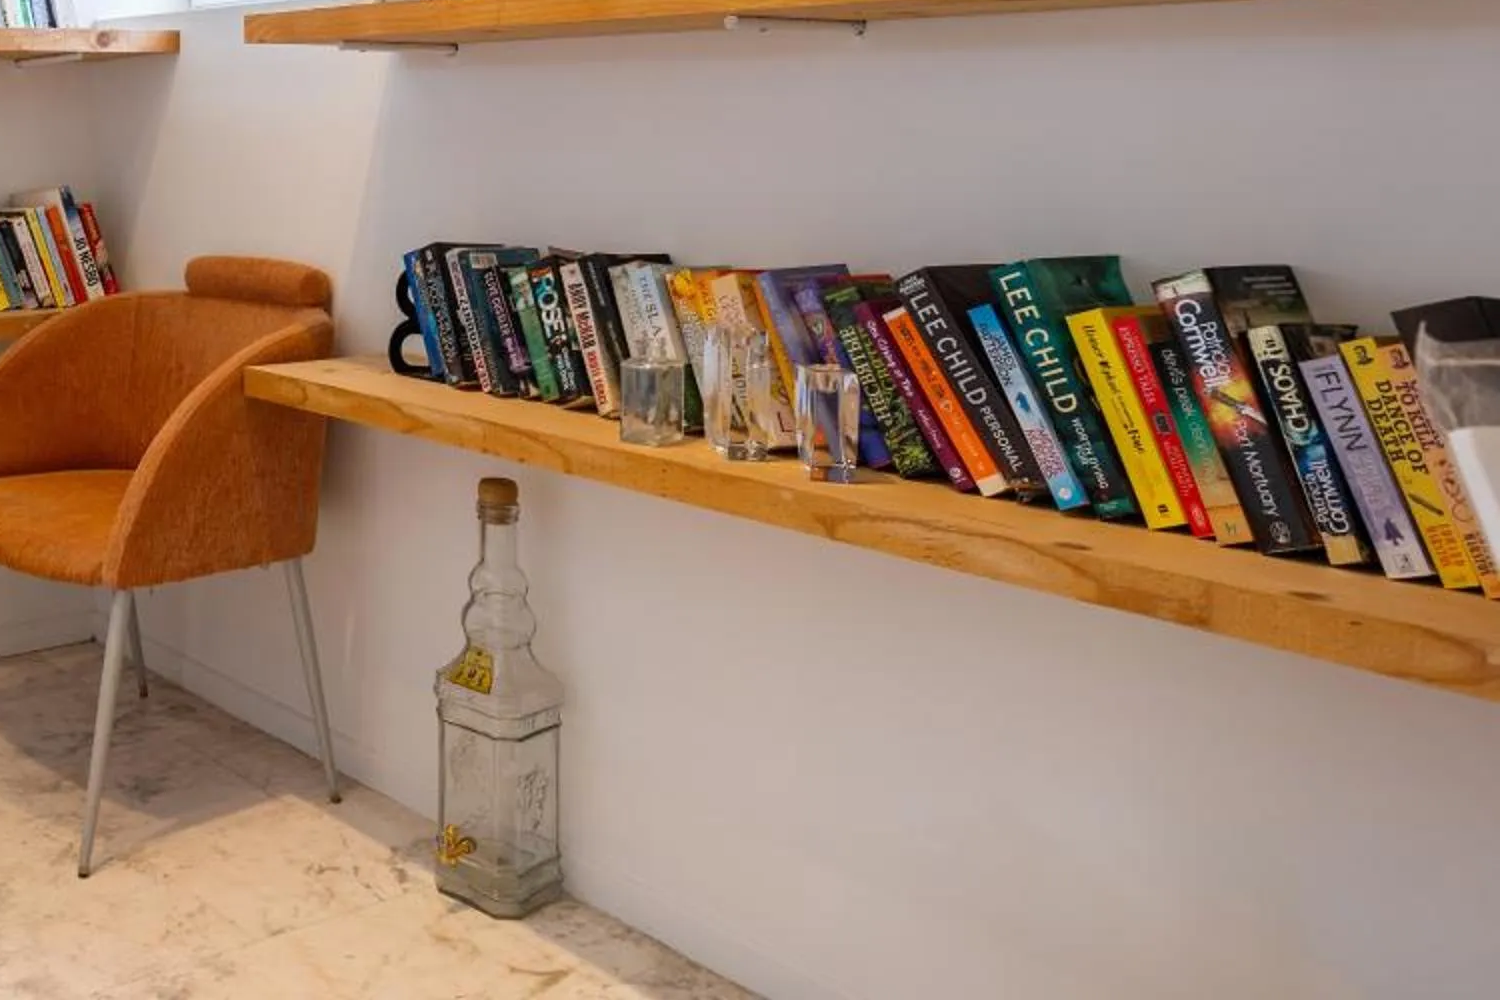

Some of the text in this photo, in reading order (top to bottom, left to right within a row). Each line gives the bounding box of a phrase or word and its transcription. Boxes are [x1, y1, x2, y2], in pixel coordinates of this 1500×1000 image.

[911, 293, 946, 333] LEE
[937, 338, 987, 405] CHILD
[980, 407, 1024, 472] PERSONAL
[999, 271, 1039, 323] LEE
[1026, 328, 1077, 413] CHILD
[1175, 299, 1230, 394] Cornwell
[1198, 320, 1232, 378] Patricia
[1271, 363, 1309, 432] CHAOS
[1315, 366, 1364, 453] FLYNN
[1366, 397, 1407, 463] DEATH
[1375, 379, 1414, 447] DANCE
[1407, 449, 1430, 475] OF
[1395, 383, 1414, 406] TO
[1407, 408, 1437, 450] KILL
[1071, 418, 1109, 489] WORTH DYING
[1231, 420, 1280, 518] Port Mortuary
[1317, 456, 1349, 534] Cornwell
